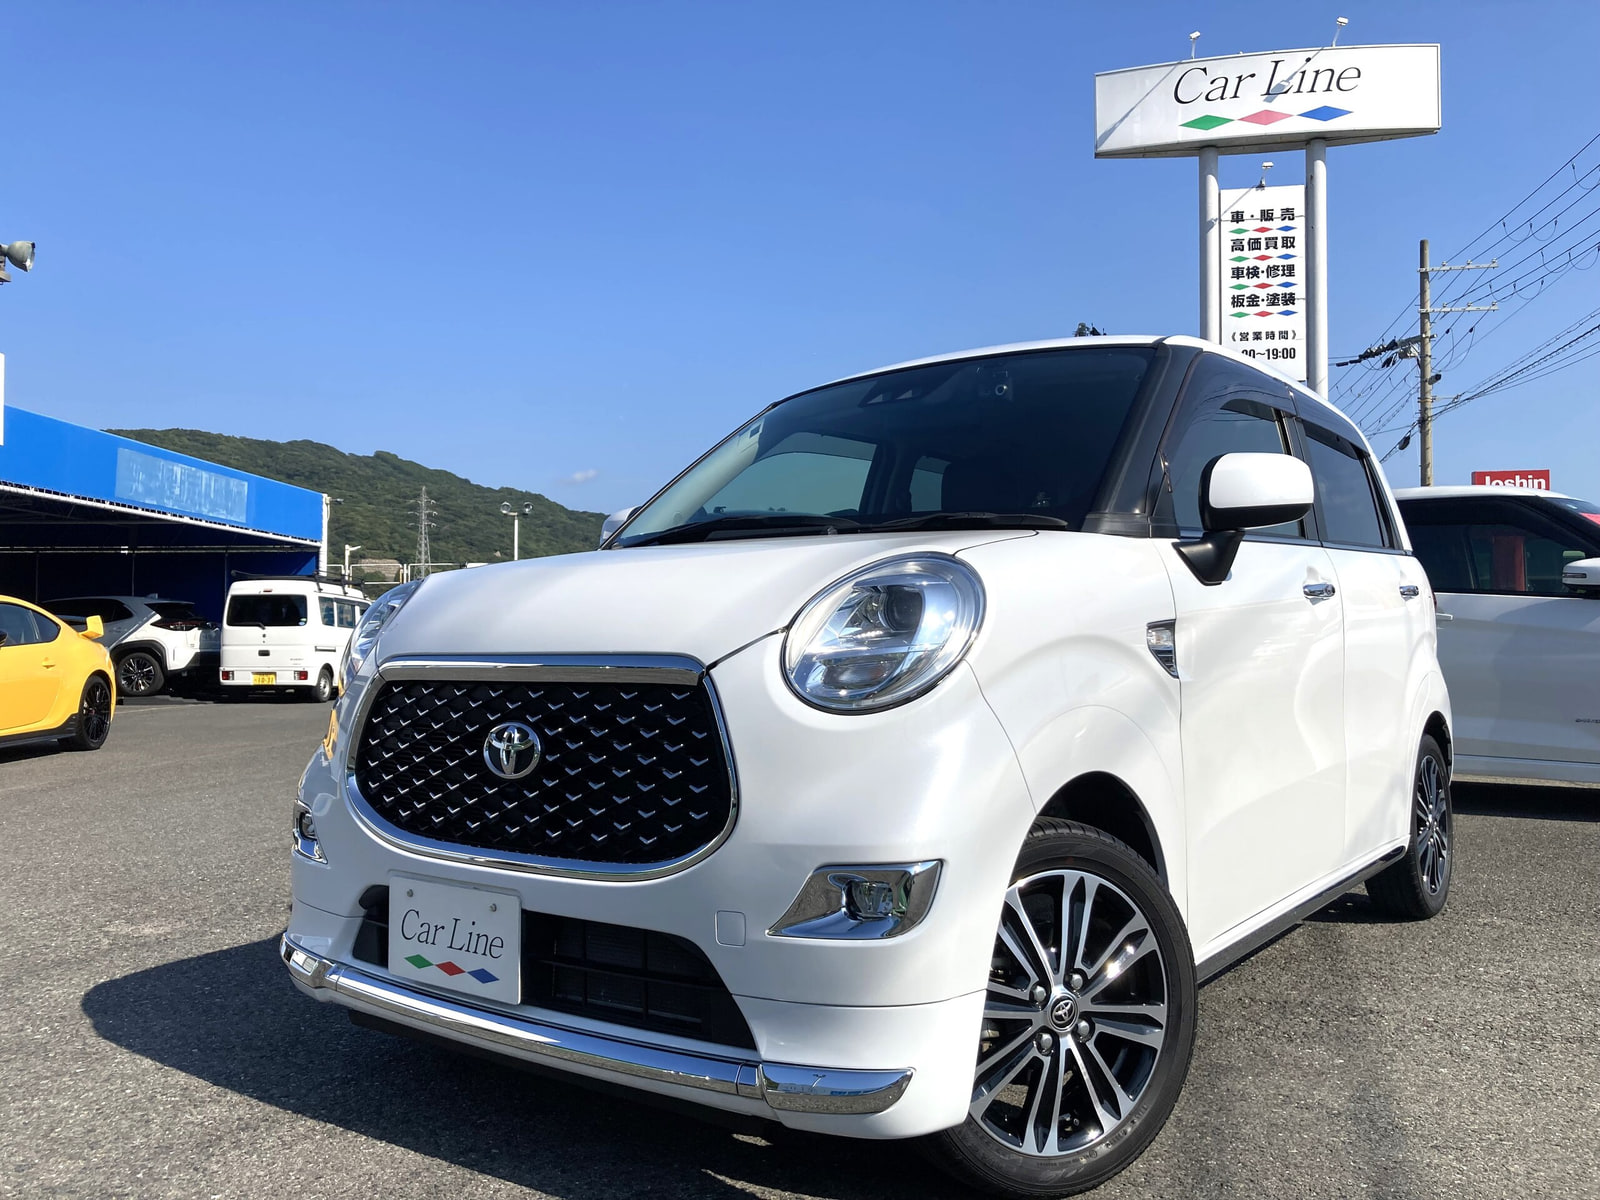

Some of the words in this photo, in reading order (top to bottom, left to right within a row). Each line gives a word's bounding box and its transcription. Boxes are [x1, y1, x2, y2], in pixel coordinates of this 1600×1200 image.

[1173, 66, 1256, 105] Car
[1260, 56, 1361, 97] Line
[1230, 236, 1296, 252] 高価買取
[1230, 264, 1296, 280] 車検・修理
[1230, 292, 1296, 308] 板金・塗装
[401, 909, 445, 946] Car
[447, 917, 504, 959] Line
